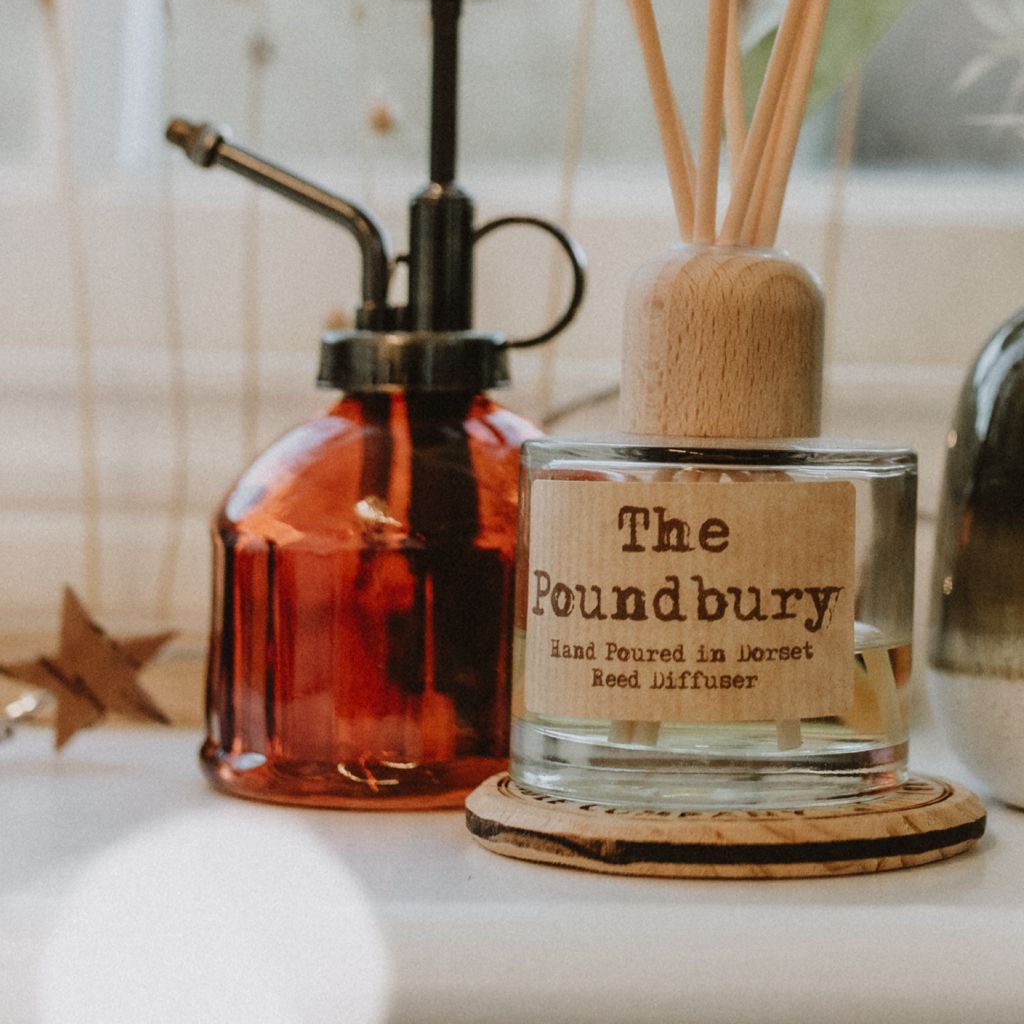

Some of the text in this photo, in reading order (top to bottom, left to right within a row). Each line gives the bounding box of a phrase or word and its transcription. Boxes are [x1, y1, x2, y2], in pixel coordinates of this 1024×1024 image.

[617, 505, 730, 553] The
[532, 570, 844, 632] Poundbury
[550, 639, 814, 663] Hand Poured in Dorset
[592, 669, 759, 690] Reed Diffuser
